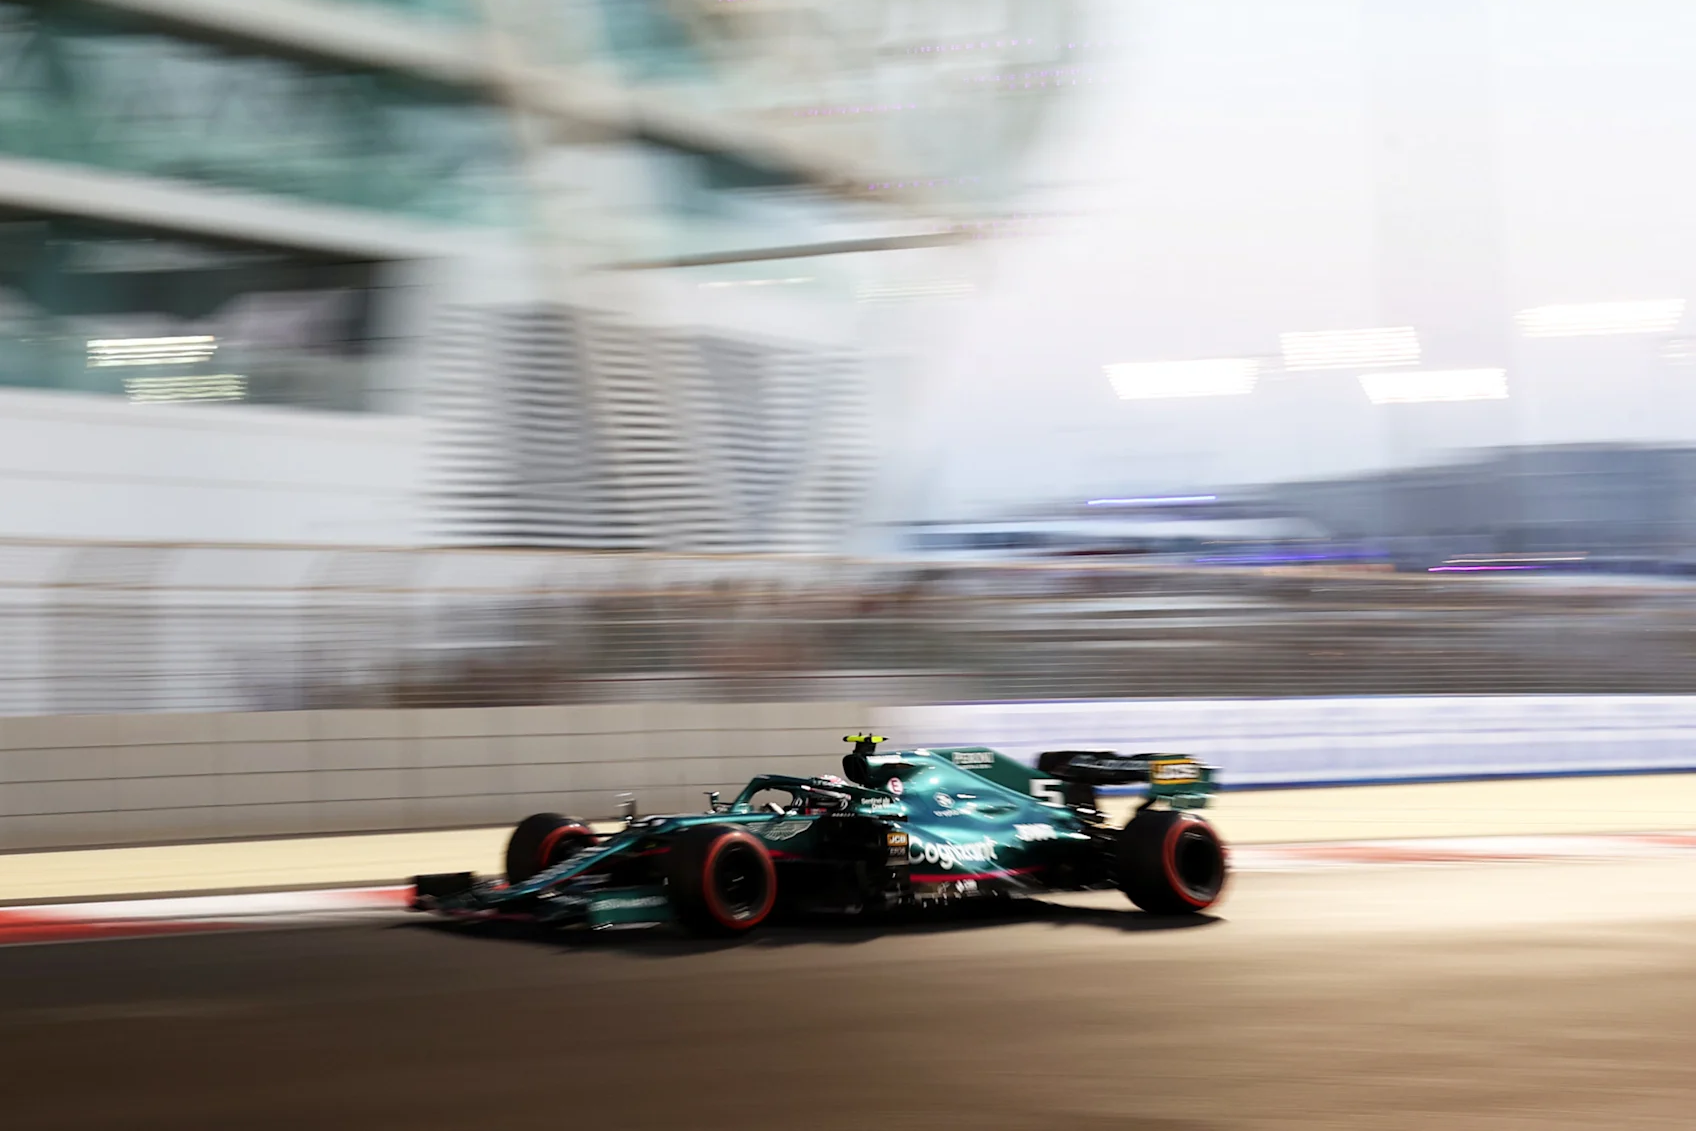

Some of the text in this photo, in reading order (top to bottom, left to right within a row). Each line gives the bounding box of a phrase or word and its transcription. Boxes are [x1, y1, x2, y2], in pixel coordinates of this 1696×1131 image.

[1029, 778, 1065, 808] 5
[888, 836, 907, 844] JCB
[908, 835, 998, 870] Cognizant
